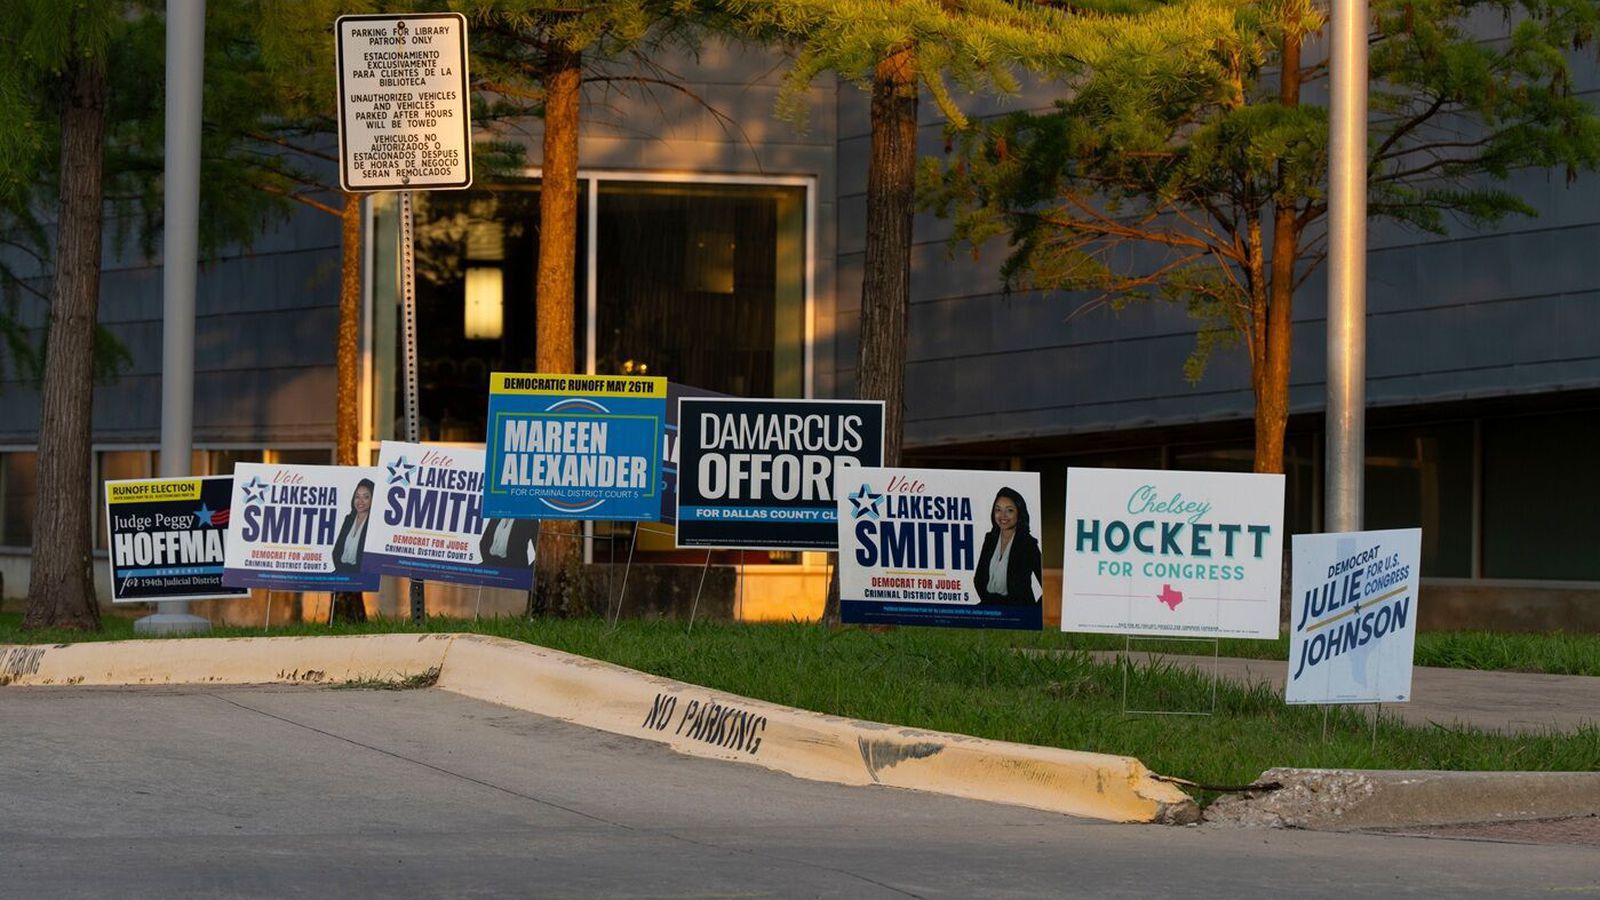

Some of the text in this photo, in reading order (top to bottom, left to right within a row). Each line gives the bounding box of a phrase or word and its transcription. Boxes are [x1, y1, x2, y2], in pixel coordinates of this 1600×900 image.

[352, 29, 387, 37] PARKING
[369, 37, 406, 45] PATRONS
[364, 51, 440, 61] ESTACIONAMIENTO
[367, 60, 437, 69] EXCLUSIVAMENTE
[352, 70, 375, 78] PARA
[379, 78, 426, 87] BIBLIOTECA
[351, 92, 456, 102] UNAUTHORIZED VEHICLES
[356, 112, 387, 120] PARKED
[353, 151, 416, 160] ESTACIONADOS
[371, 143, 429, 152] AUTORIZADOS
[354, 161, 365, 169] DE
[362, 168, 451, 178] SERAN REMOLCADOS
[504, 378, 654, 393] DEMOCRATIC RUNOFF MAY 26TH
[504, 420, 608, 453] MAREEN
[700, 412, 863, 452] DAMARCUS
[420, 450, 454, 466] Vote
[273, 470, 303, 484] Vote
[500, 454, 647, 488] ALEXANDER
[698, 453, 862, 501] OFFOR
[113, 484, 194, 495] RUNOFF ELECTION
[529, 489, 565, 497] CRIMINAL
[887, 476, 926, 494] Vote
[271, 485, 337, 506] LAKESHA
[384, 486, 483, 536] SMITH
[886, 495, 972, 520] LAKESHA
[1127, 484, 1212, 524] Chelsey
[696, 509, 719, 518] FOR
[723, 509, 768, 518] DALLAS
[769, 510, 820, 519] COUNTY
[114, 514, 194, 531] Judge Peggy
[242, 505, 337, 545] SMITH
[393, 534, 469, 550] DEMOCRAT FOR JUDGE
[855, 520, 974, 570] SMITH
[1076, 519, 1271, 558] HOCKETT
[114, 529, 229, 566] HOFFMA
[252, 550, 286, 560] DEMOCRAT
[302, 553, 323, 561] JUDGE
[385, 544, 415, 555] CRIMINAL
[418, 548, 445, 558] DISTRICT
[447, 552, 467, 560] COURT
[244, 559, 273, 568] CRIMINAL
[1328, 545, 1381, 578] DEMOCRAT
[1366, 553, 1400, 579] FOR U.S.
[1098, 561, 1245, 580] FOR CONGRESS
[120, 571, 138, 596] for
[164, 577, 191, 587] Judicial
[193, 576, 220, 585] District
[872, 577, 961, 590] DEMOCRAT FOR JUDGE
[1364, 565, 1409, 596] CONGRESS
[864, 589, 969, 601] CRIMINAL DISTRICT COURT 5
[1297, 568, 1364, 632] JULIE
[1294, 597, 1410, 681] JOHNSON
[642, 694, 767, 754] NO PARKING
